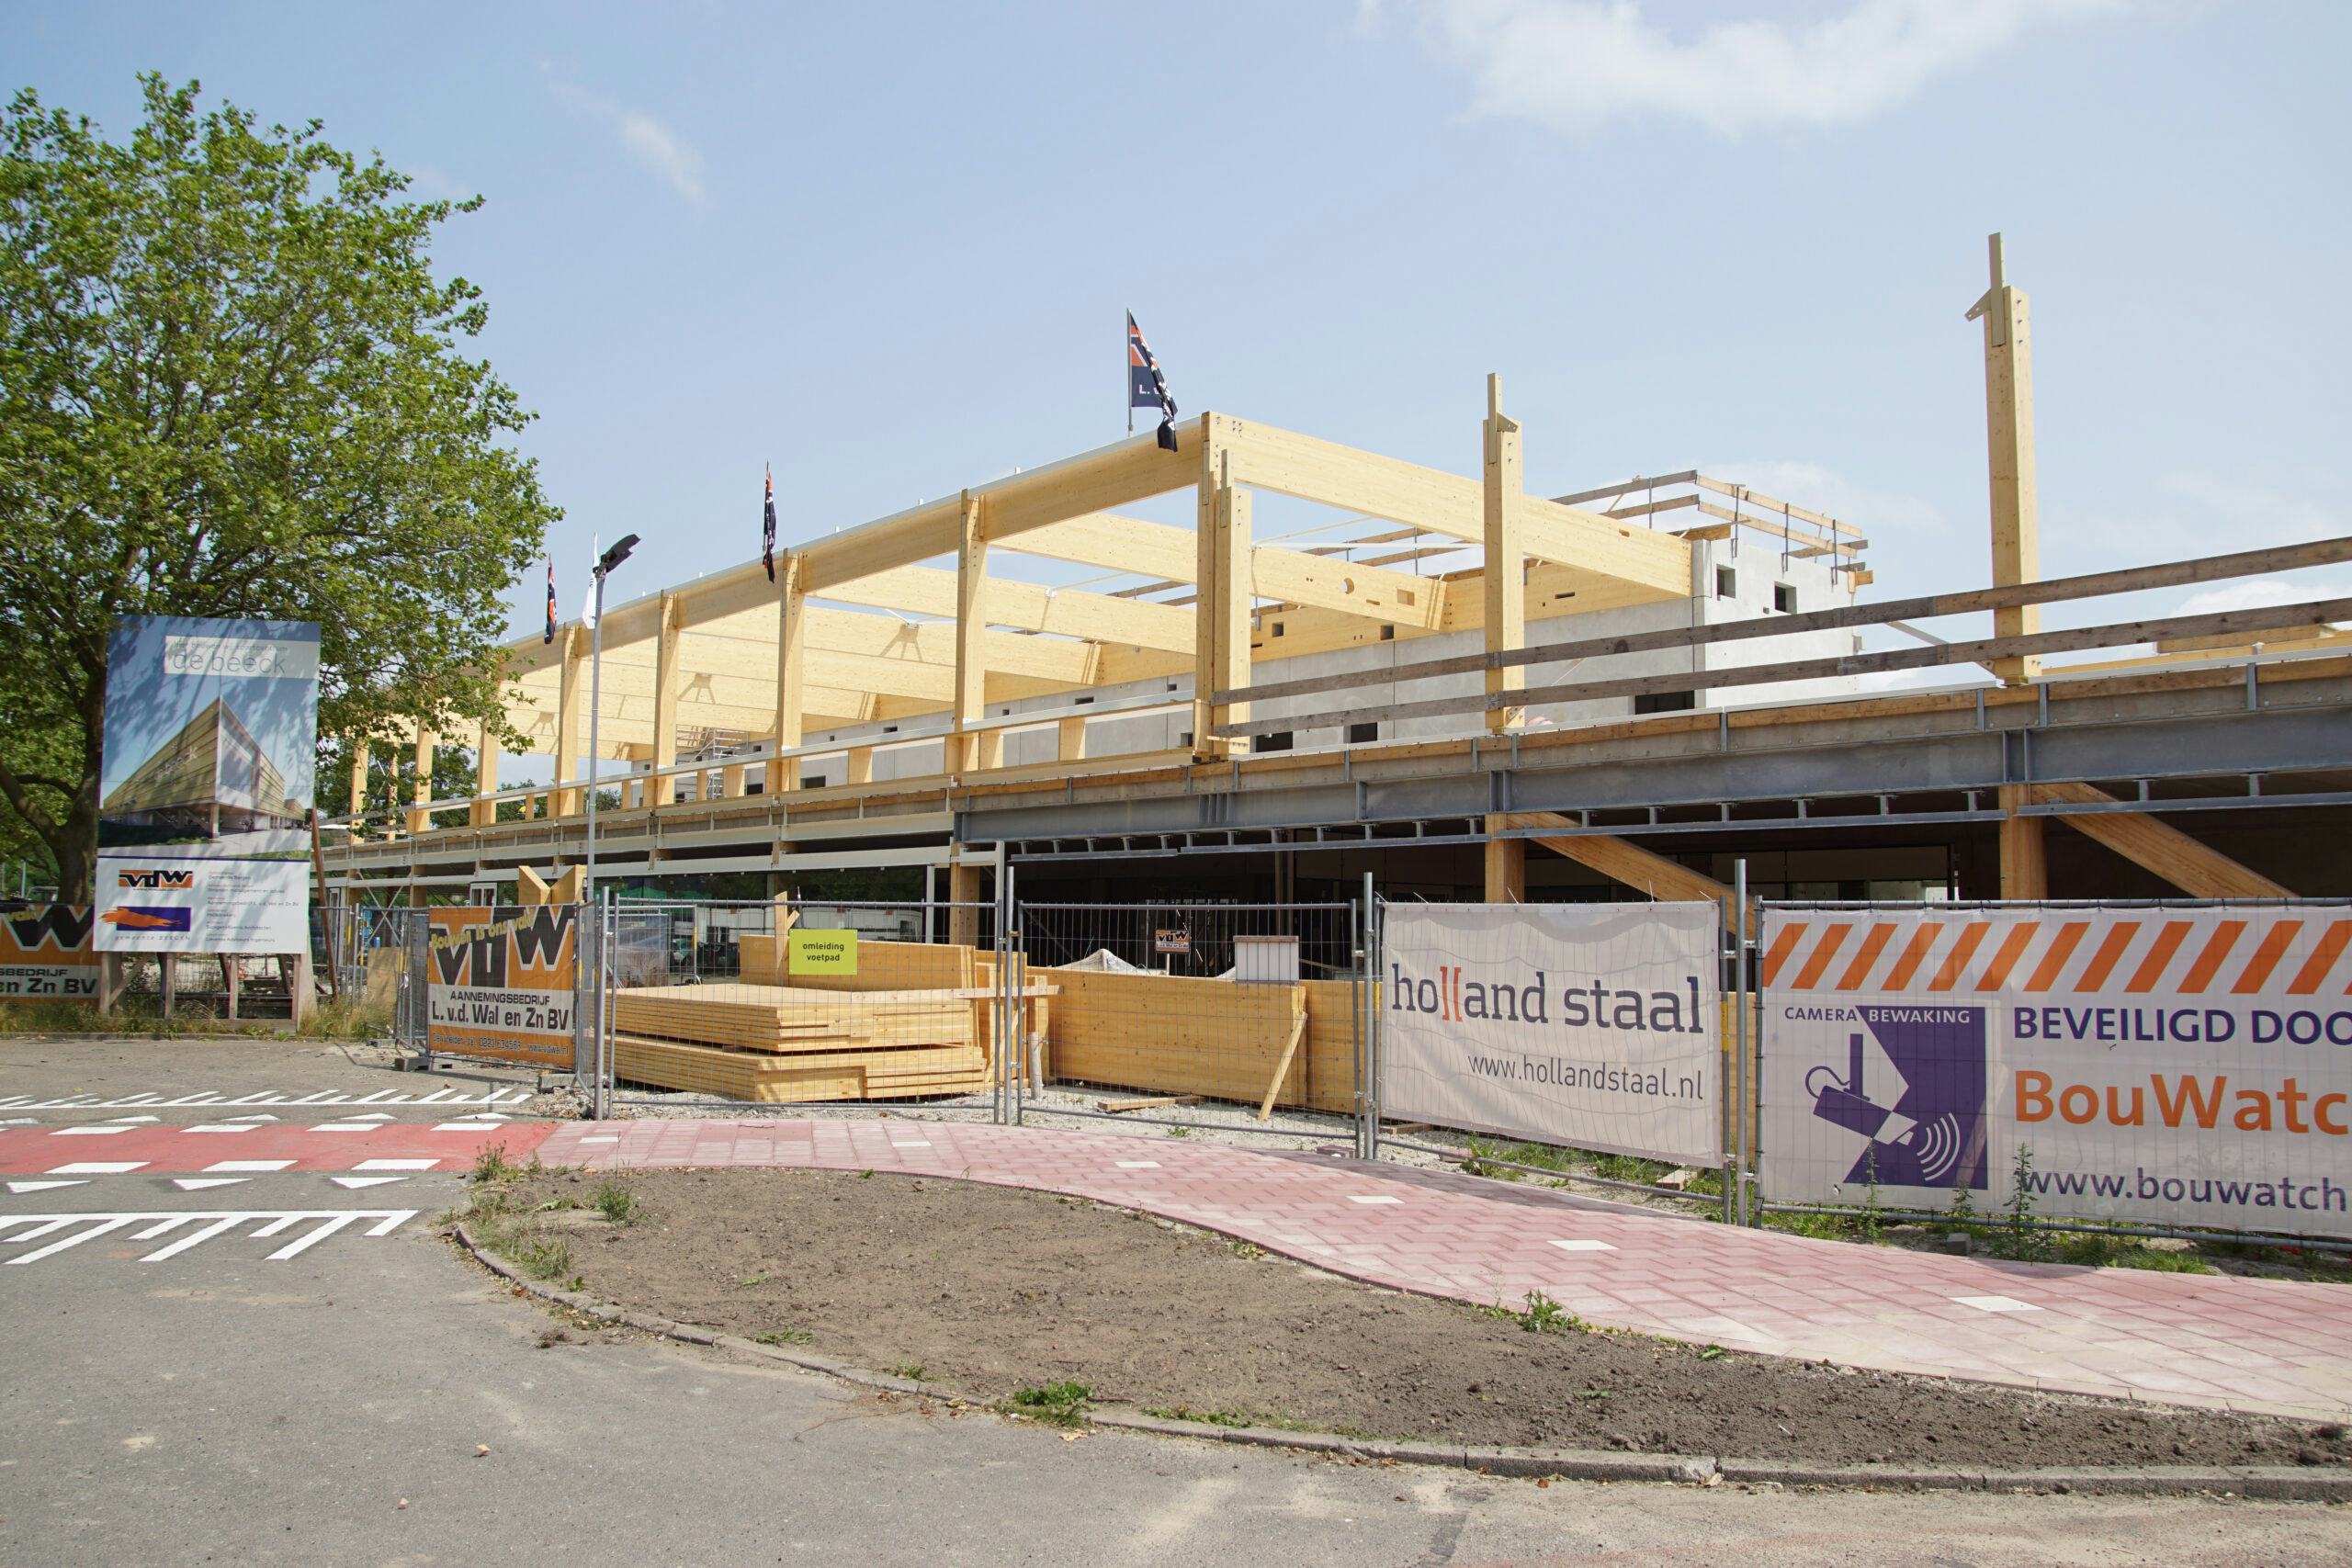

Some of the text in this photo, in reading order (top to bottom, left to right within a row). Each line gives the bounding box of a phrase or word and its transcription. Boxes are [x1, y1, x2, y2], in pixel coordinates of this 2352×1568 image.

[173, 648, 286, 673] de beeck
[802, 942, 844, 952] omleiding
[807, 953, 840, 963] voetpad
[28, 977, 56, 993] Zn
[63, 978, 97, 994] BV
[450, 990, 550, 1006] AANNEMINGSBEDRIJF
[1391, 963, 1704, 1034] holland staal
[432, 1000, 444, 1021] L.
[472, 1003, 499, 1025] Wal
[504, 1010, 521, 1027] en
[526, 1007, 544, 1029] Zn
[547, 1008, 569, 1031] BV
[1784, 1007, 1970, 1024] CAMERA BEWAKING
[2013, 1007, 2236, 1043] BEVEILIGD
[1467, 1055, 1704, 1100] www.hollandstaal.nl
